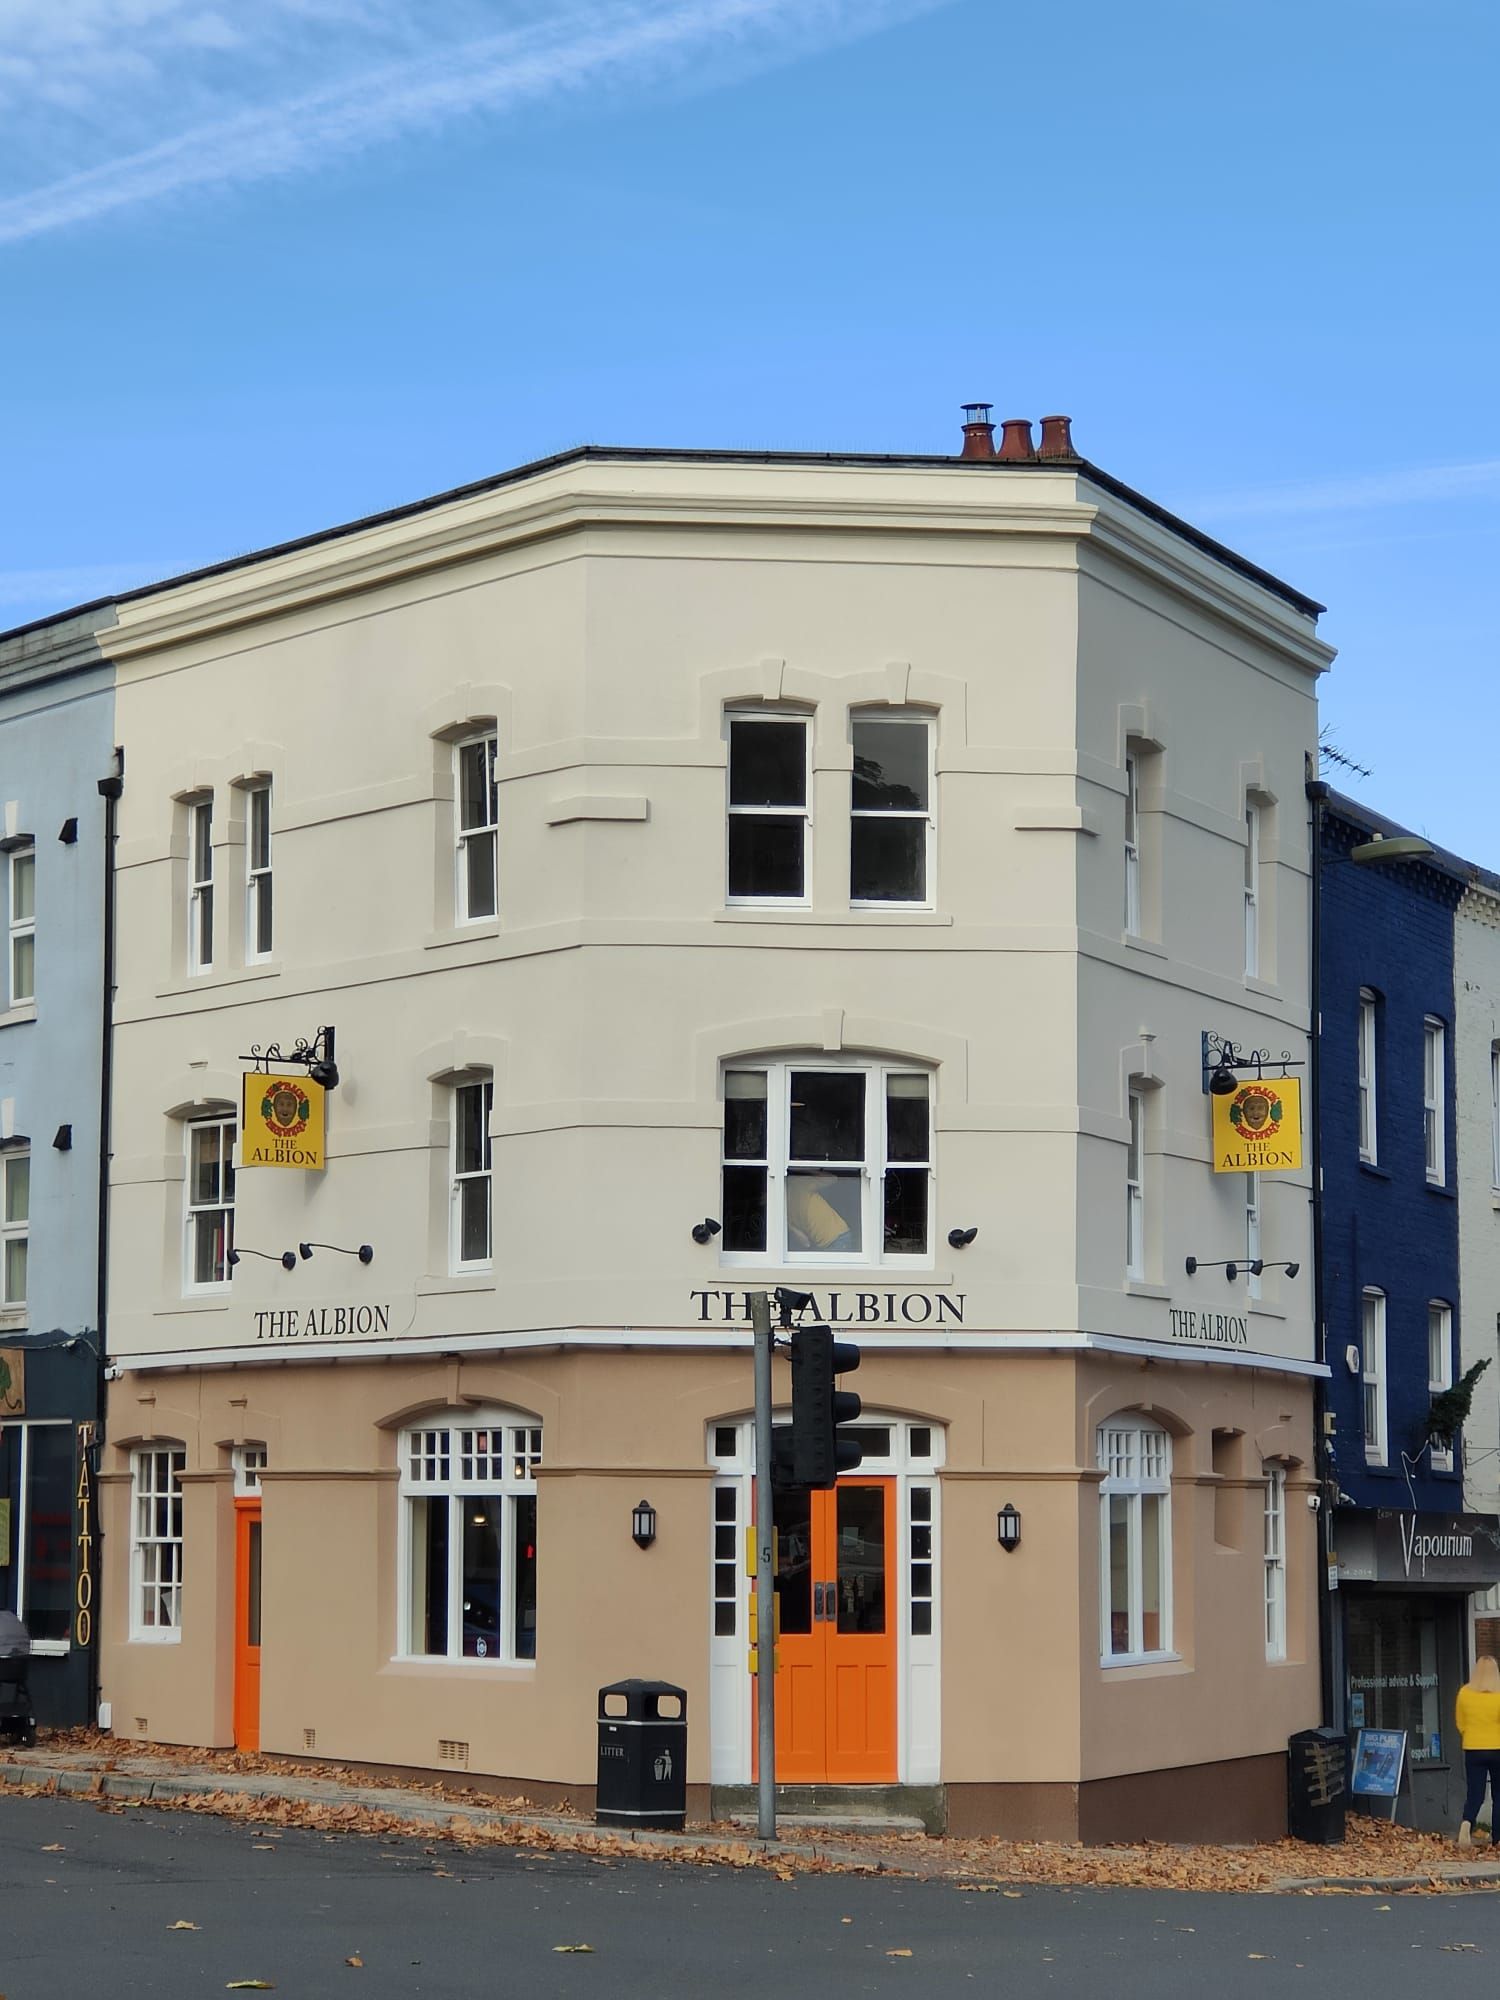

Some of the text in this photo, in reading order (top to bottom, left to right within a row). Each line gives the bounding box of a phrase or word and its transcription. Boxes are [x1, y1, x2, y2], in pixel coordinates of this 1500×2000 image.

[272, 1138, 297, 1150] THE
[1243, 1142, 1271, 1153] THE
[251, 1147, 318, 1165] ALBION
[1221, 1151, 1294, 1168] ALBION
[793, 1291, 968, 1324] ALBION
[254, 1304, 390, 1339] THE ALBION
[1169, 1308, 1248, 1345] THE ALBION
[77, 1424, 92, 1646] TATTOO
[1400, 1513, 1473, 1578] Vapourium
[1351, 1673, 1388, 1689] Professional
[1389, 1673, 1408, 1688] advice
[1416, 1671, 1438, 1688] Support
[600, 1746, 624, 1757] LITTER
